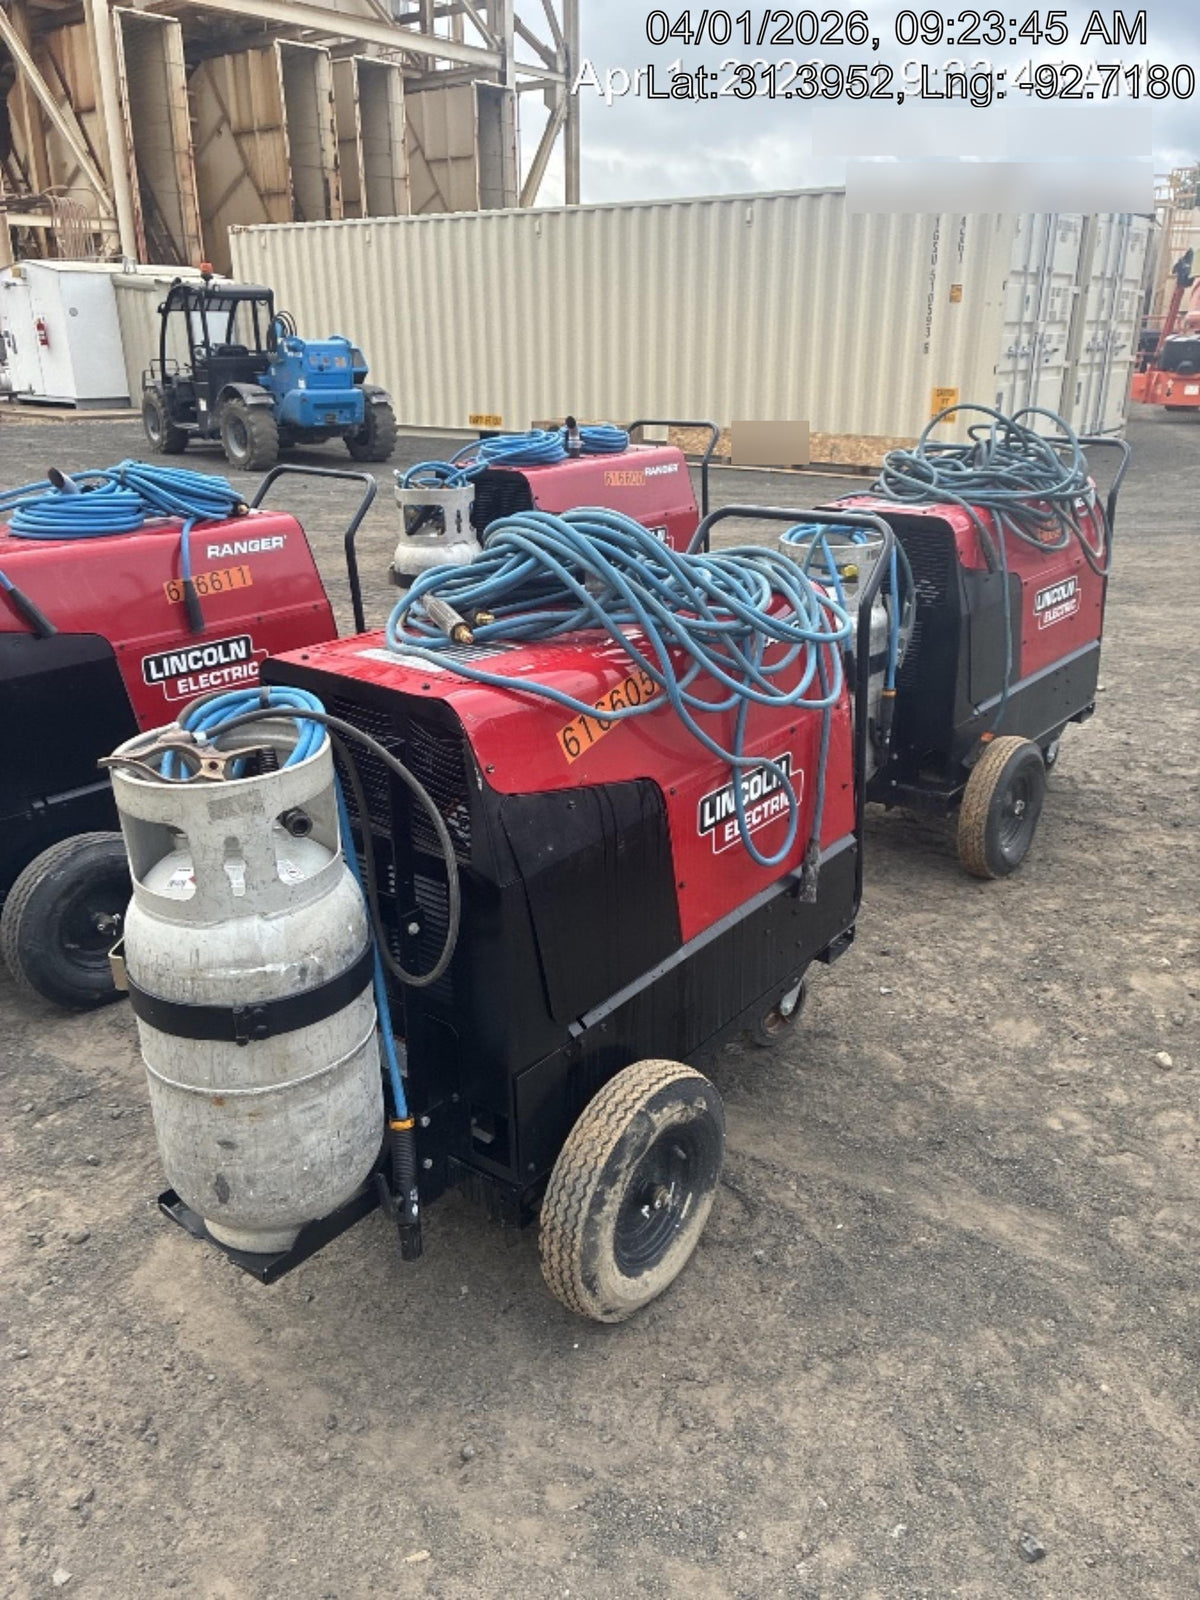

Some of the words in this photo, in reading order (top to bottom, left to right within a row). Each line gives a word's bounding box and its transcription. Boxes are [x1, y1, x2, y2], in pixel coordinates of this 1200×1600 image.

[644, 463, 679, 476] RANGER
[207, 536, 284, 559] RANGER
[166, 567, 247, 602] 66611
[1035, 581, 1076, 611] LINCOLN
[148, 639, 247, 680] LINCOLN
[176, 661, 260, 695] ELECTRIC
